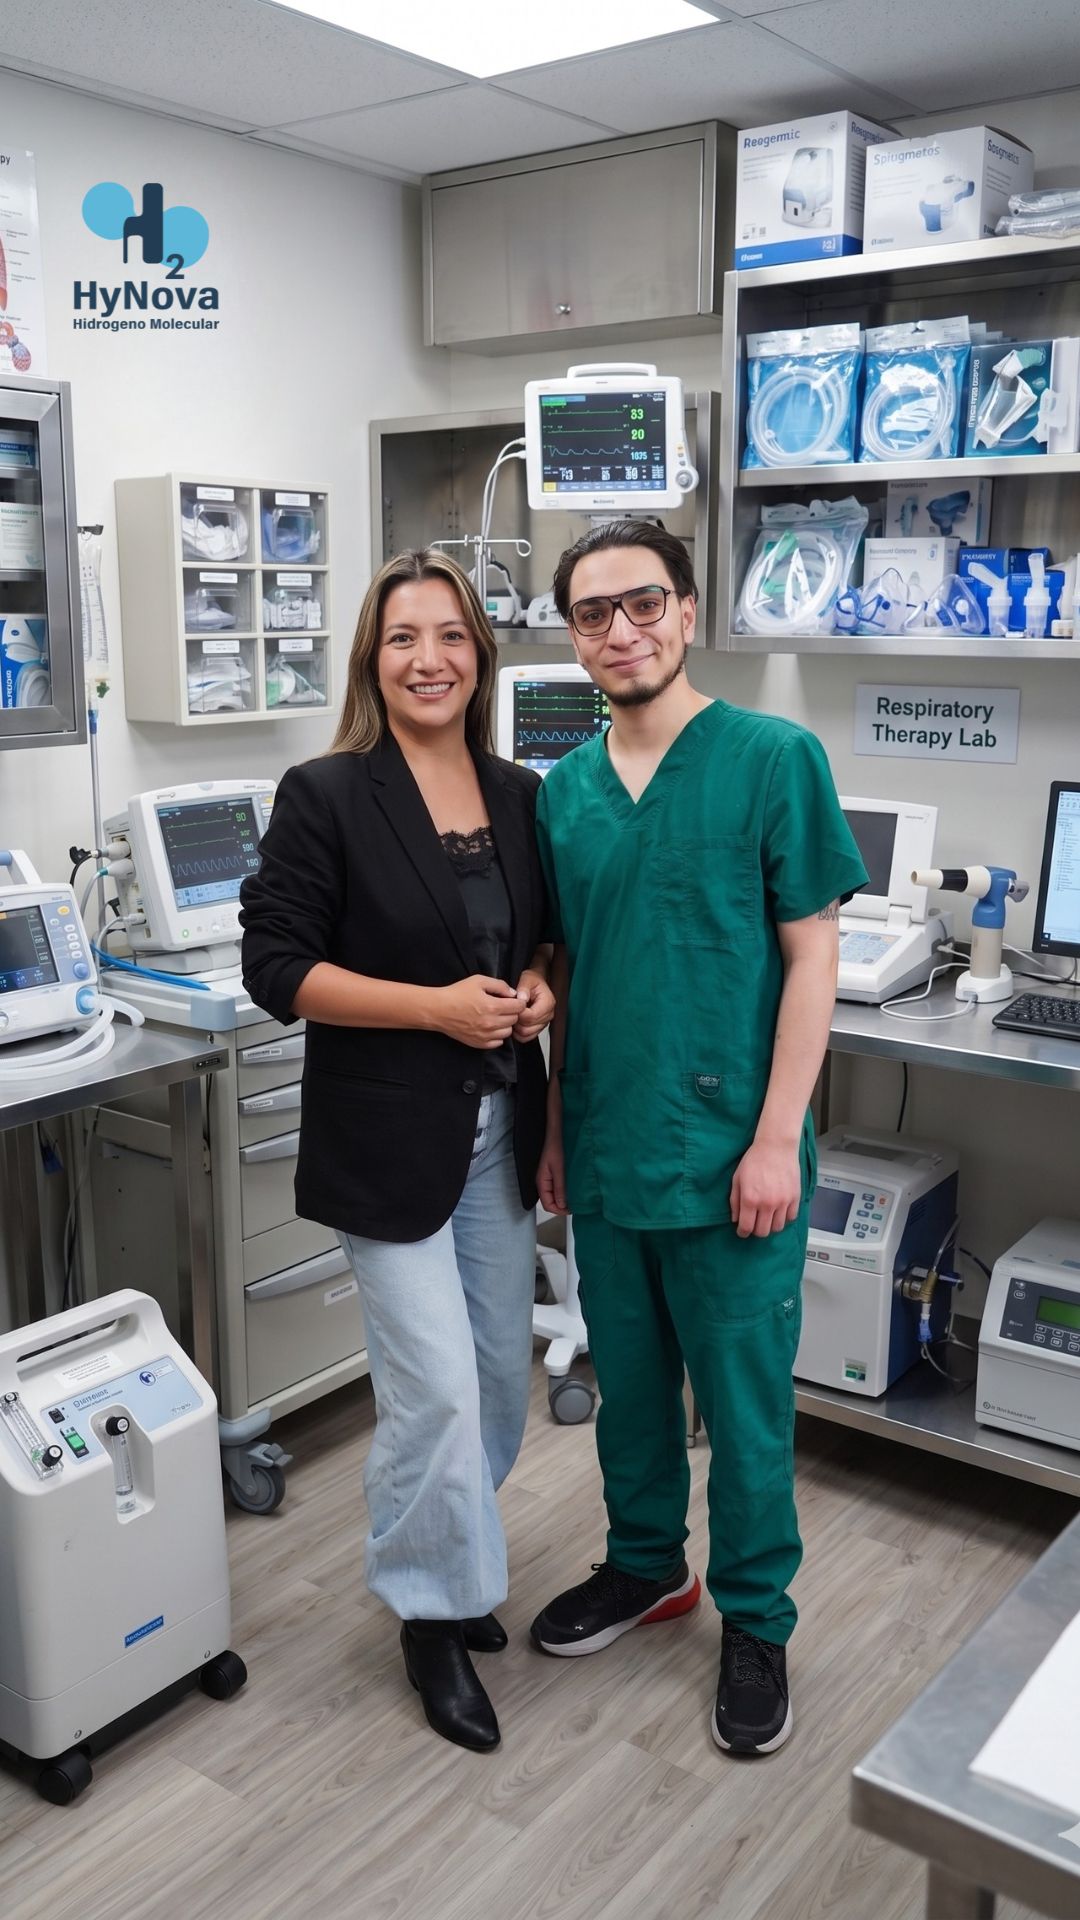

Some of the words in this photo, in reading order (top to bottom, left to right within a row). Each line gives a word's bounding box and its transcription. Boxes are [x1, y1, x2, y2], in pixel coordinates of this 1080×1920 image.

[631, 428, 645, 440] 20
[876, 697, 994, 724] Respiratory
[872, 724, 952, 750] Therapy
[959, 728, 997, 748] Lab
